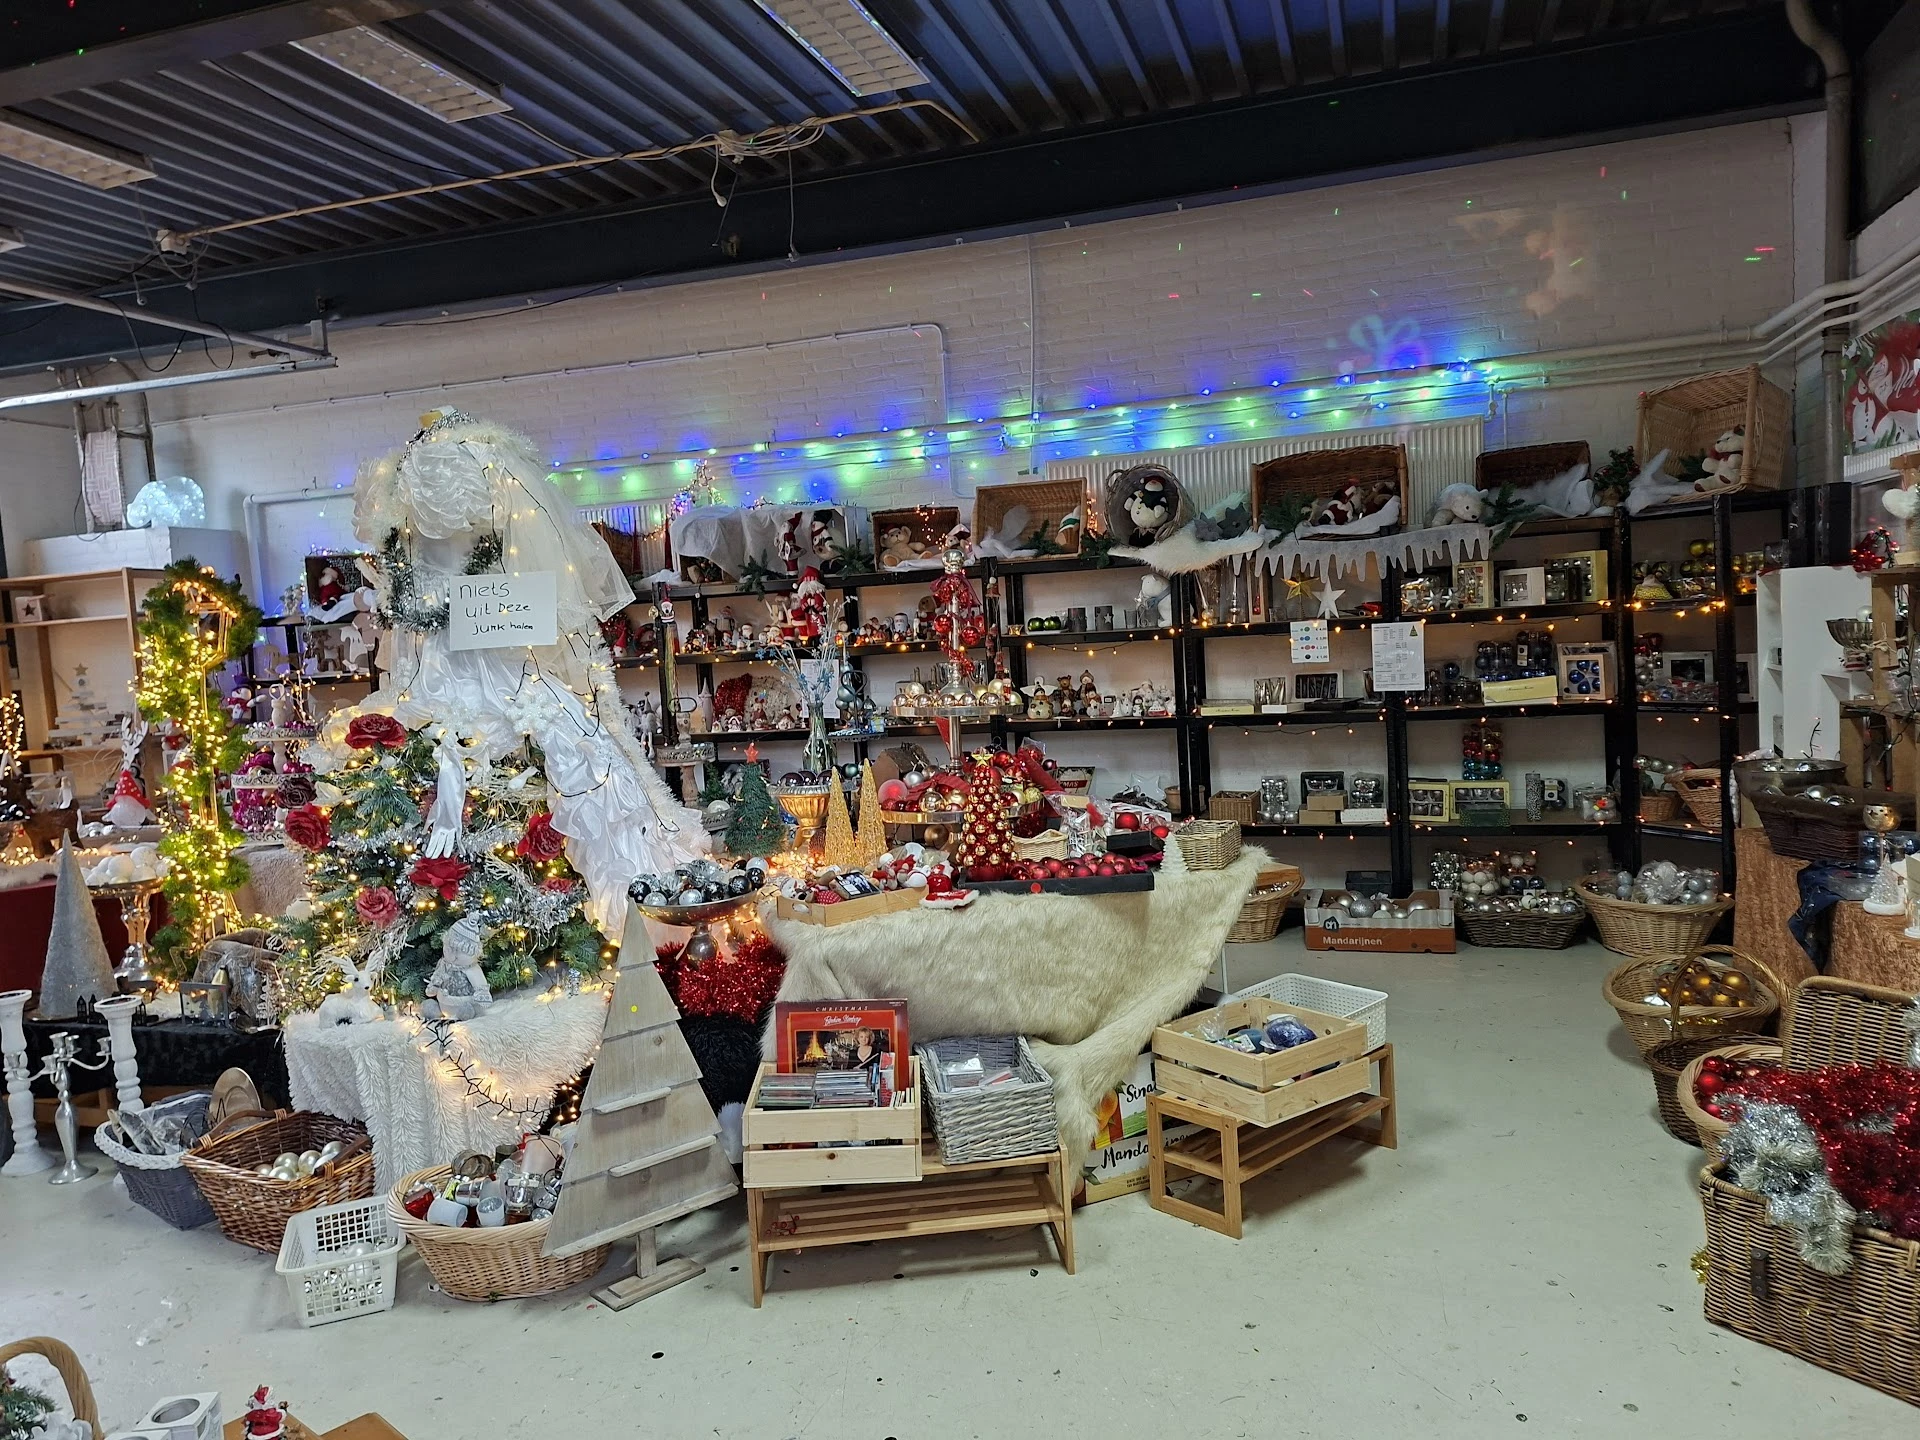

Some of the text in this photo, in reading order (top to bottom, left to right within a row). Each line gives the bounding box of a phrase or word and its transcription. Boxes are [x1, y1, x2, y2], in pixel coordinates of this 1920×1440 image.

[460, 581, 510, 599] niets
[465, 603, 491, 618] uit
[509, 621, 534, 630] halen
[1322, 936, 1383, 946] Mandarijnen
